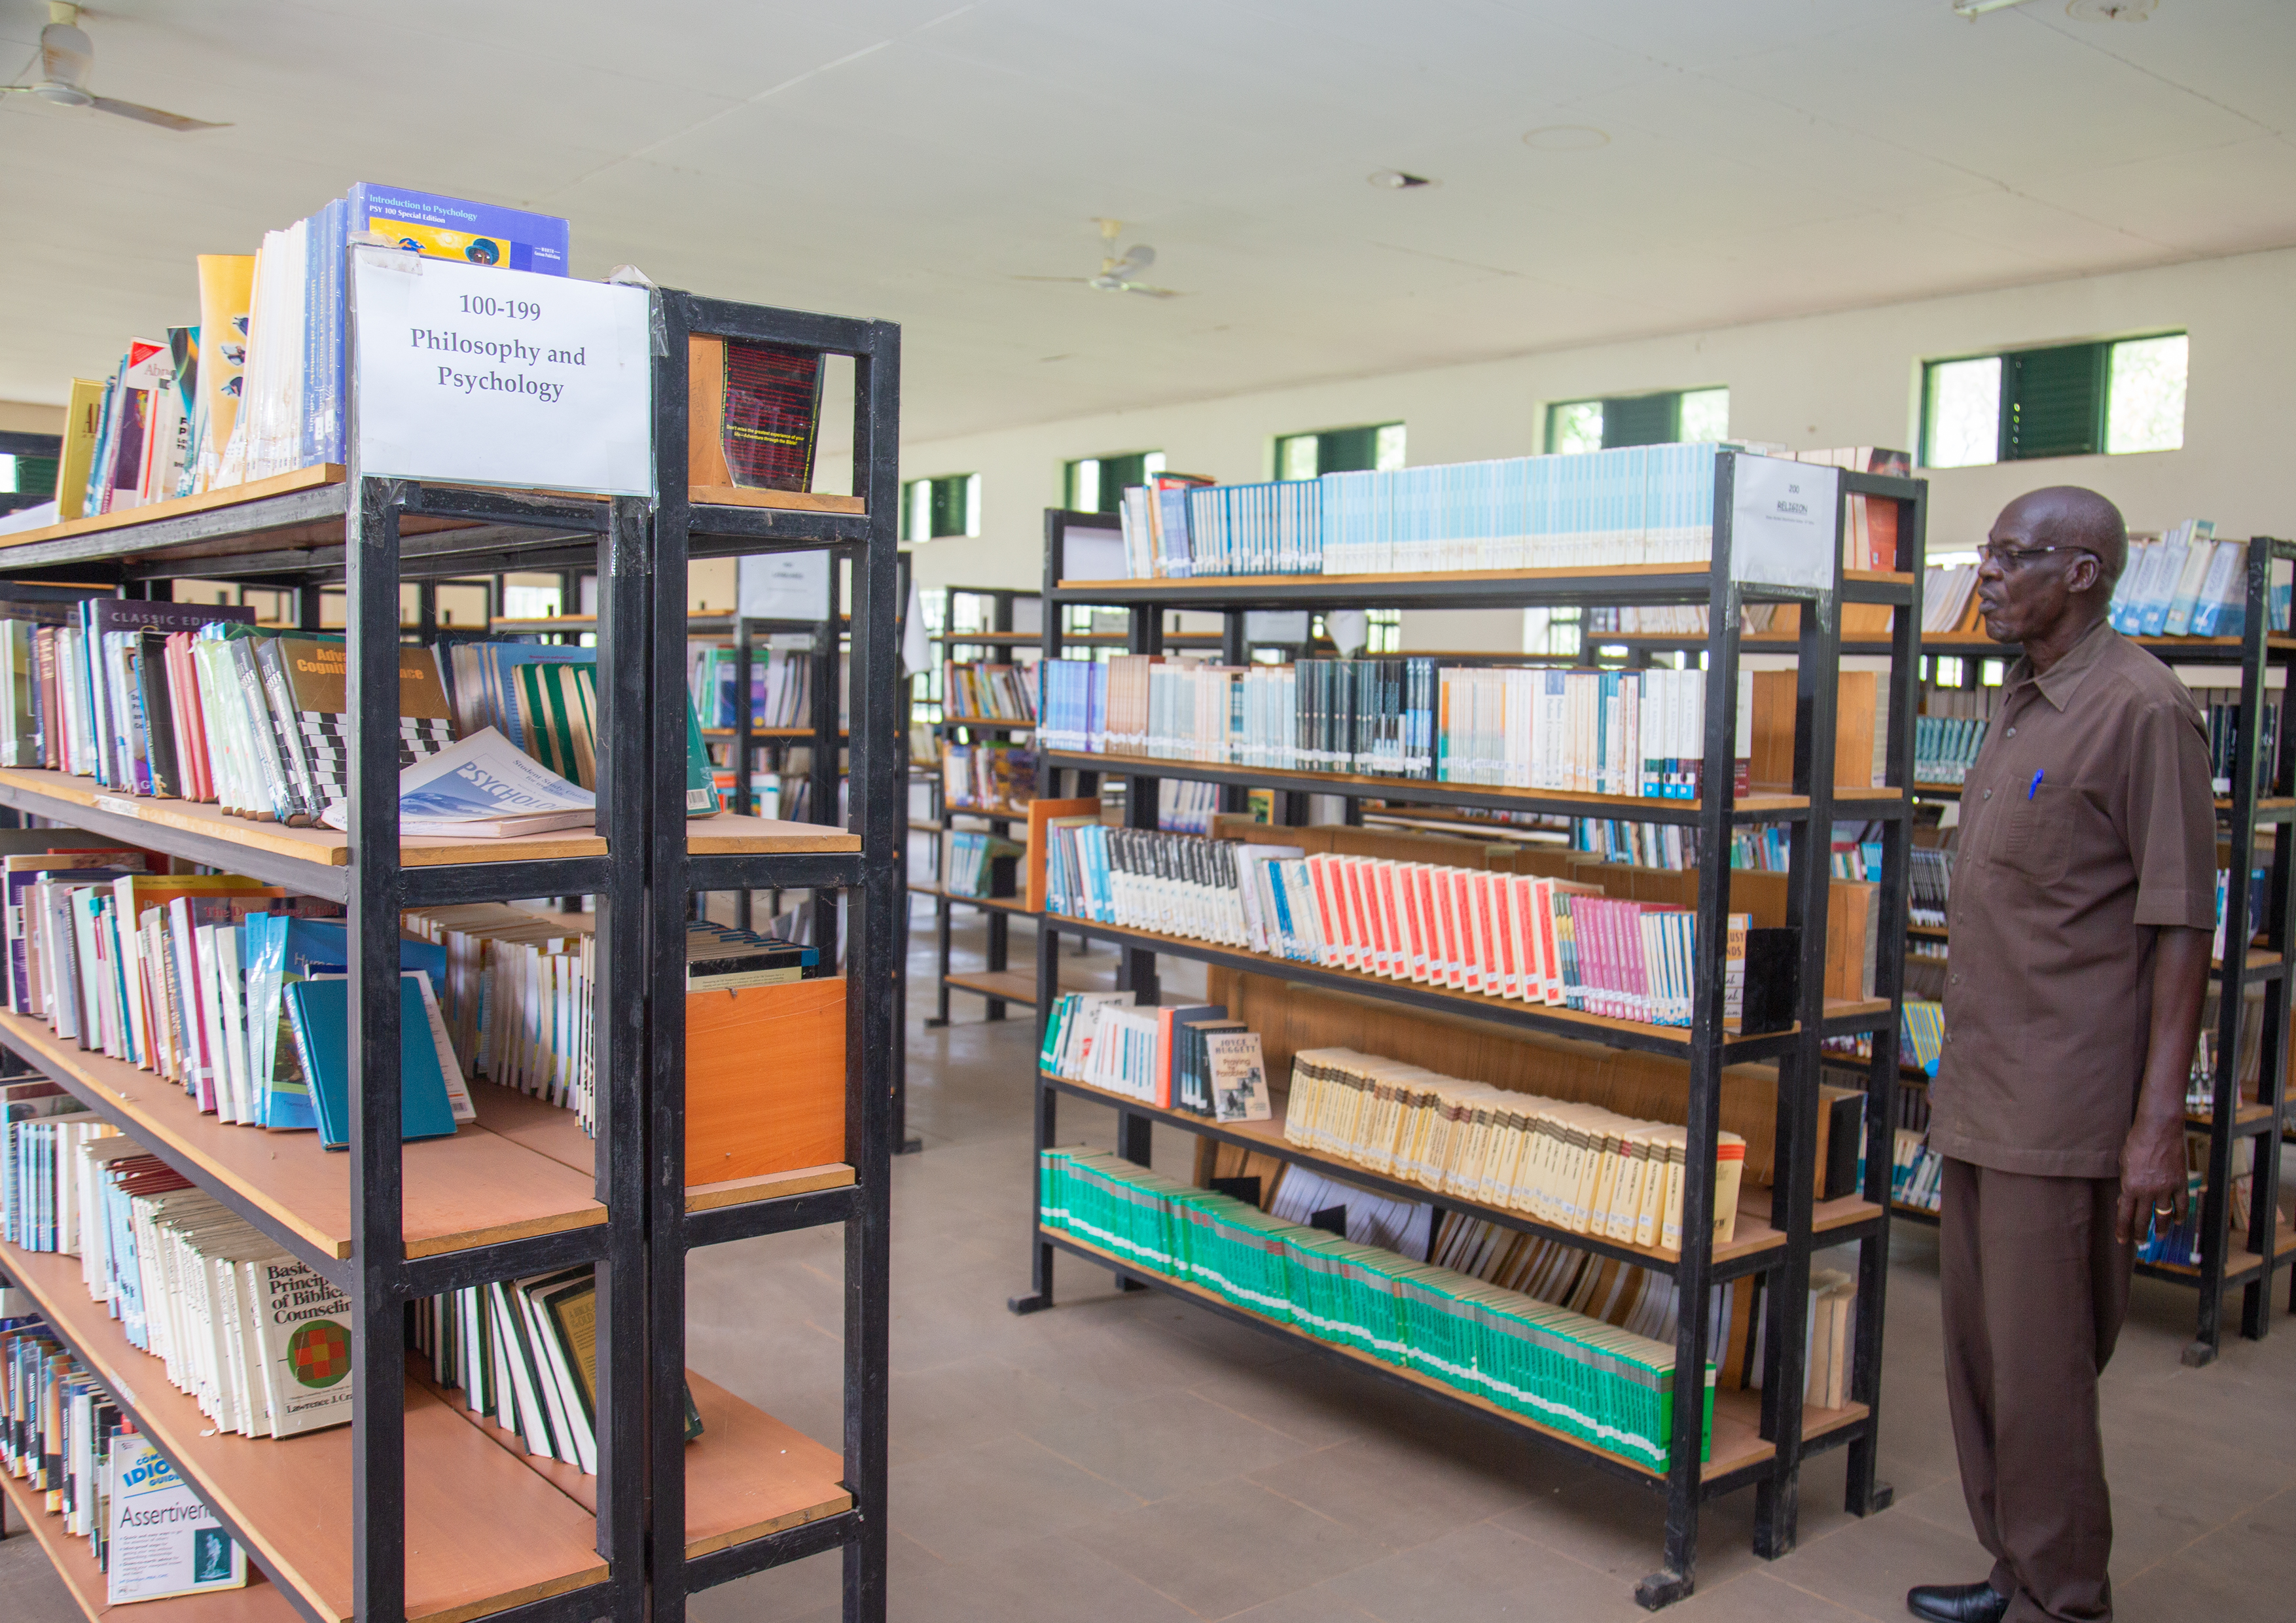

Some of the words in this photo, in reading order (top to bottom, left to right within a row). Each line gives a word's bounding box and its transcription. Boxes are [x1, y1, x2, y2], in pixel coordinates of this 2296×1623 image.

[369, 205, 383, 213] PSY
[384, 207, 397, 215] 100
[398, 209, 422, 220] Special
[423, 213, 446, 224] Edition
[370, 194, 421, 211] Introduction
[423, 203, 431, 211] to
[433, 205, 477, 222] Psychology
[545, 252, 561, 260] Publishing
[460, 294, 541, 321] 100-199
[329, 319, 334, 329] of
[310, 330, 315, 340] of
[410, 328, 541, 366] Philosophy
[547, 347, 586, 366] and
[437, 366, 564, 402] Psychology
[1777, 501, 1808, 513] RELIGION
[111, 612, 174, 626] CLASSIC
[316, 649, 346, 662] Adva
[513, 759, 542, 779] Student
[543, 777, 563, 793] Study
[565, 790, 589, 800] Guide
[526, 776, 535, 785] for
[535, 781, 546, 790] use
[548, 787, 564, 796] with
[204, 906, 229, 917] The
[305, 904, 340, 917] Child
[1730, 933, 1744, 942] UST
[250, 1013, 262, 1087] Development
[1215, 1046, 1255, 1054] HUGGETT
[266, 1261, 312, 1279] Basic
[269, 1273, 331, 1295] Princip
[271, 1294, 289, 1310] of
[292, 1286, 347, 1306] Biblic
[274, 1299, 351, 1324] Counselin
[287, 1397, 329, 1414] Lawrence
[331, 1395, 338, 1404] J.
[136, 1453, 162, 1466] COM
[122, 1459, 171, 1488] IDIO
[119, 1501, 213, 1529] Assertiven
